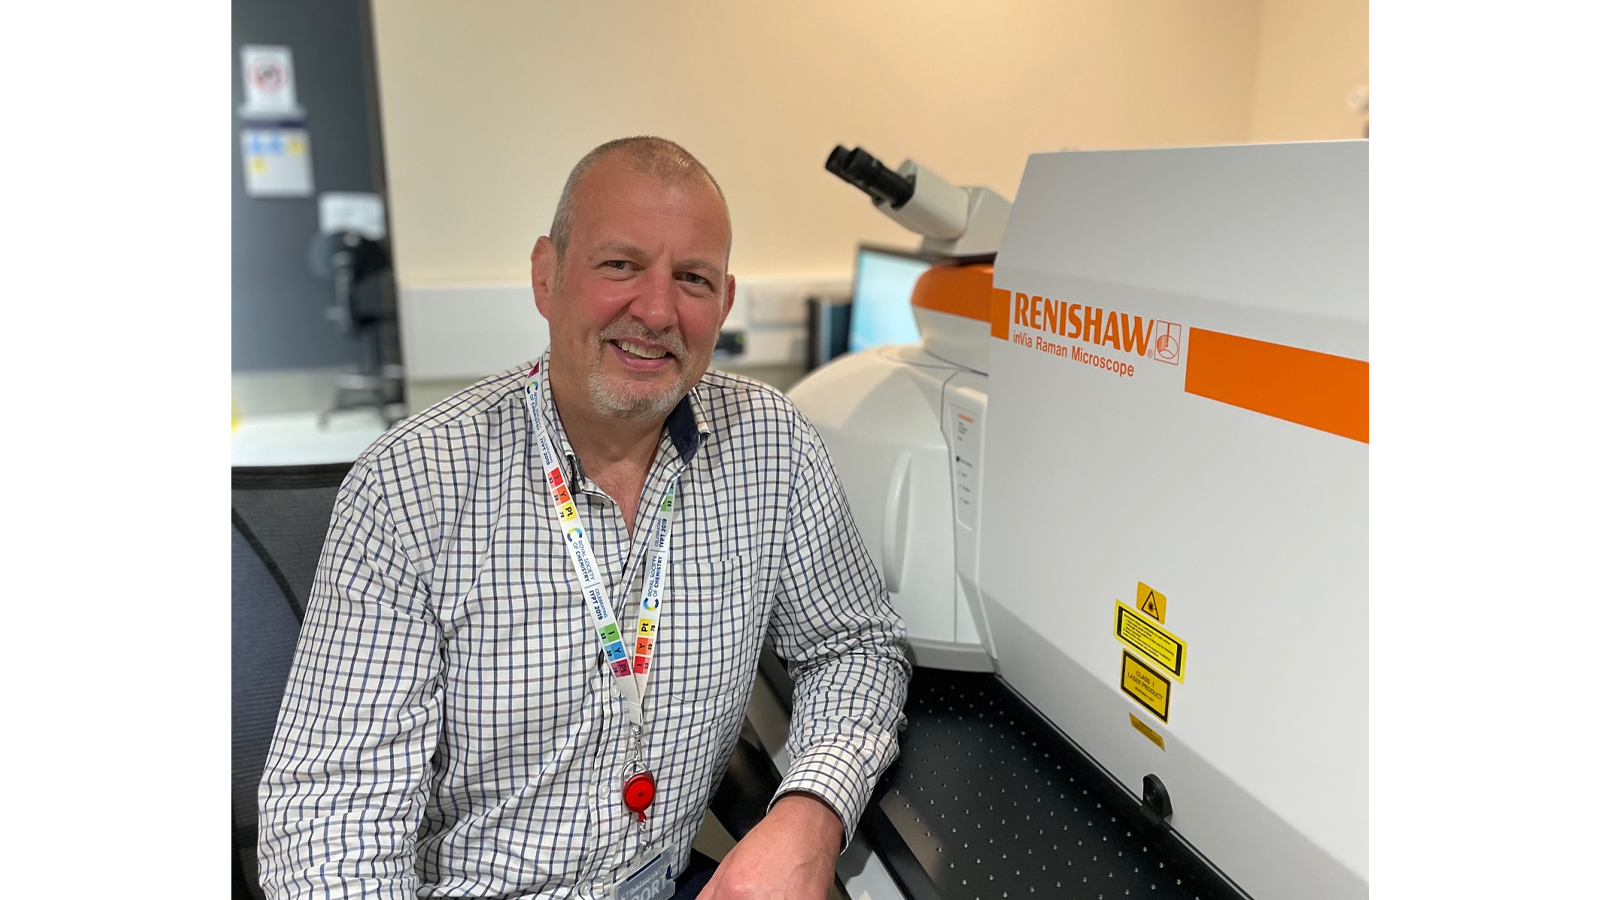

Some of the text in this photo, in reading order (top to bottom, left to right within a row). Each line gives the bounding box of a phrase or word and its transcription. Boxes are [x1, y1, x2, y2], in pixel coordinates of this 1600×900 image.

[1014, 292, 1154, 357] RENISHAW
[1013, 330, 1134, 377] inVia Raman Microscope
[529, 393, 534, 401] OF
[565, 506, 573, 517] Pt
[572, 541, 589, 582] OF CHEMISTRY
[578, 539, 595, 580] ROYAL SOCIETY
[653, 556, 663, 597] OF CHEMISTRY
[589, 590, 603, 620] IYPT 2019
[595, 588, 608, 618] CELEBRATING
[640, 622, 648, 632] Pt
[619, 663, 628, 674] Pt
[1136, 670, 1151, 685] CLASS
[1128, 672, 1141, 686] LASER
[1142, 682, 1163, 701] PRODUCT
